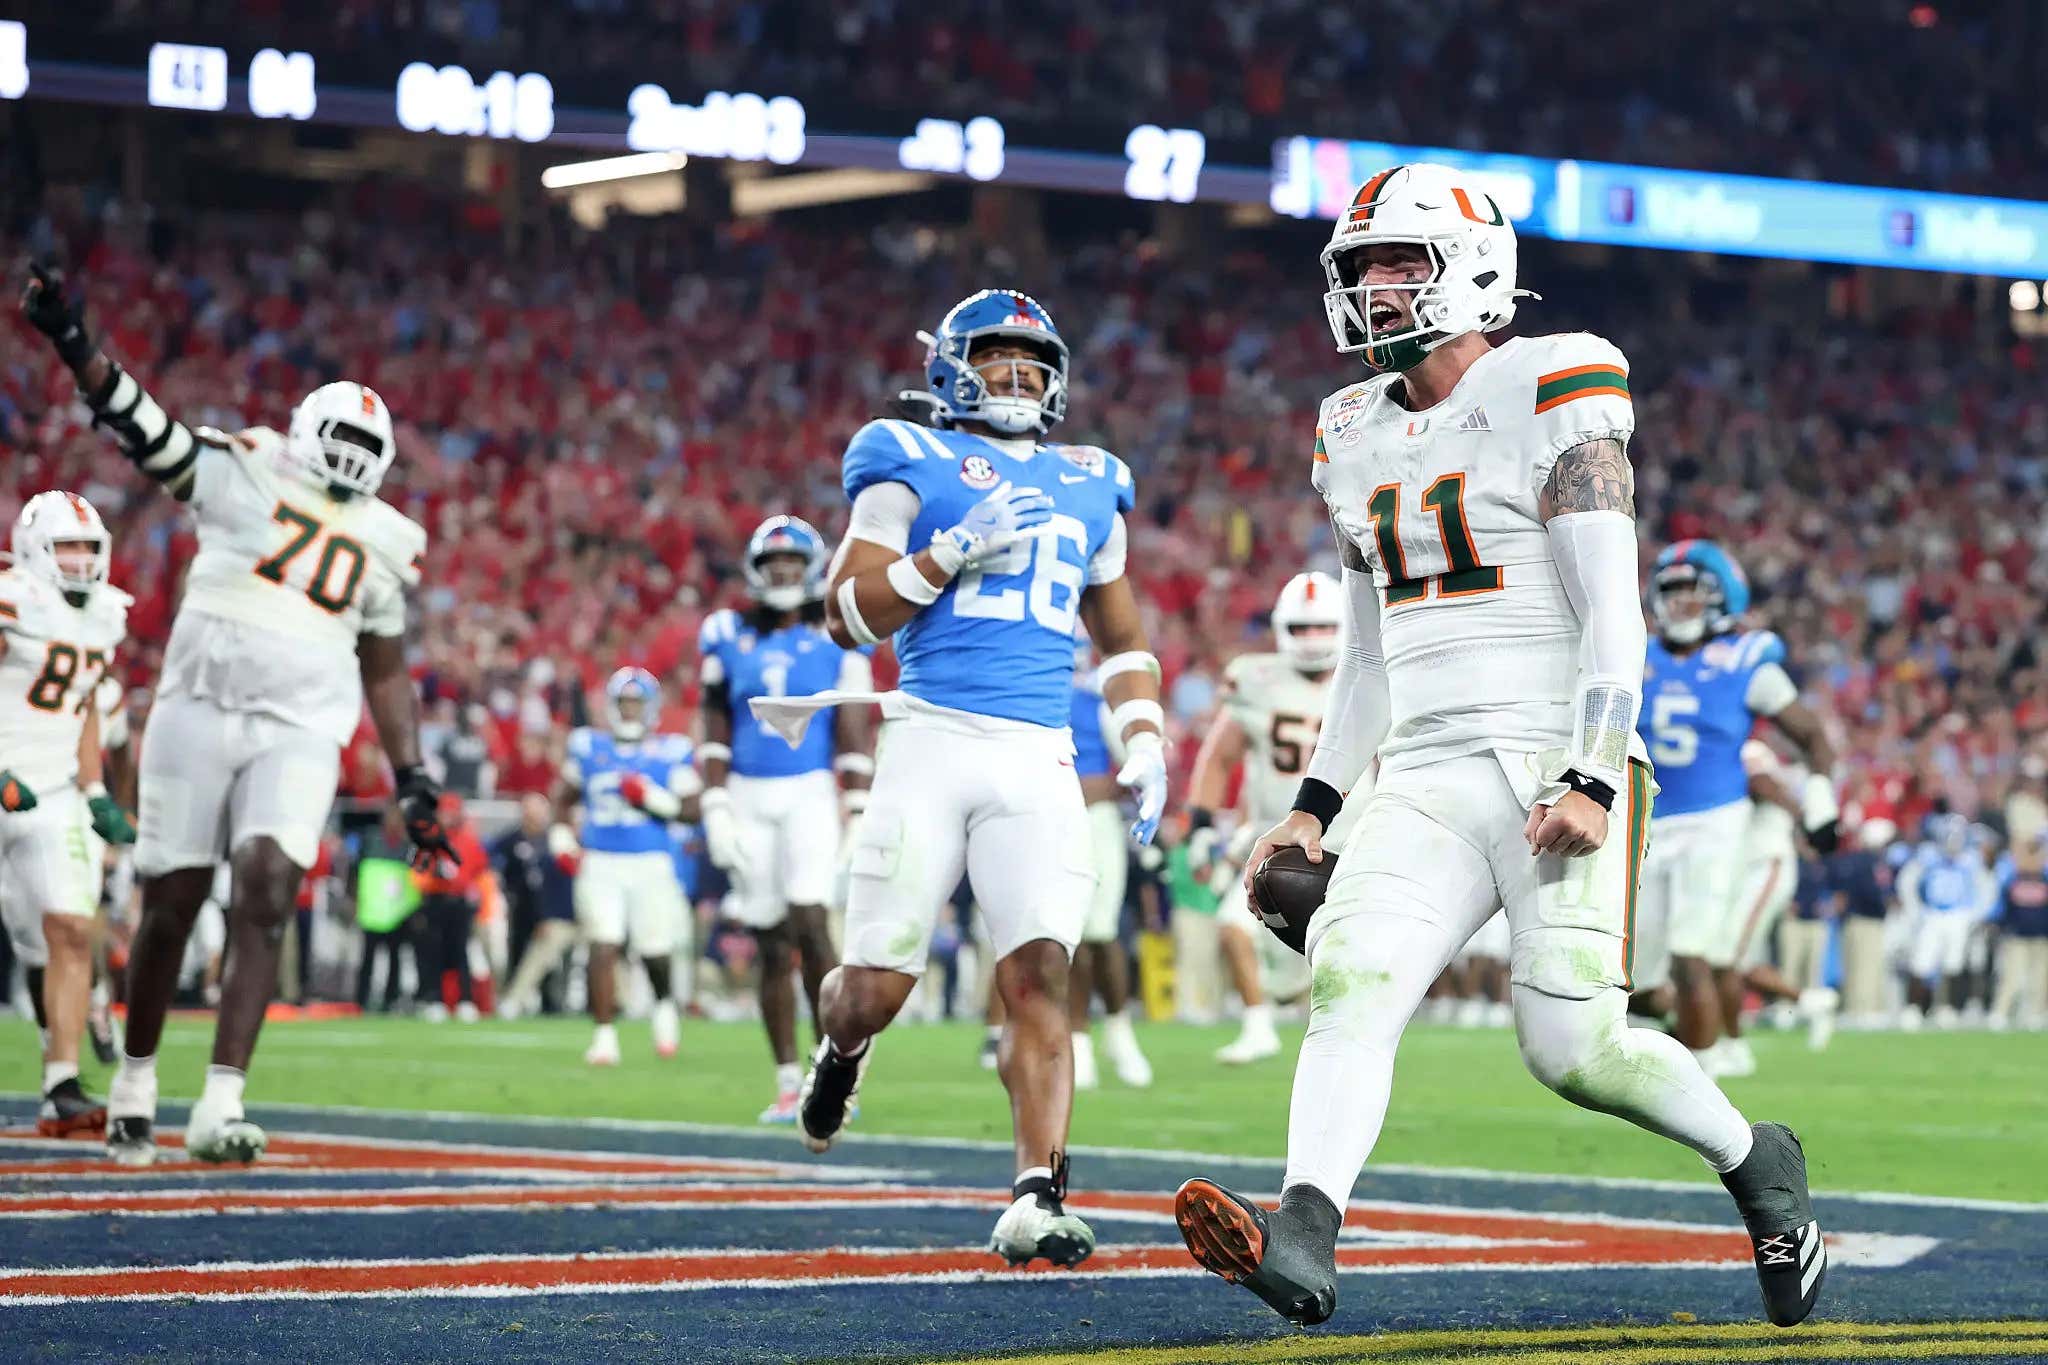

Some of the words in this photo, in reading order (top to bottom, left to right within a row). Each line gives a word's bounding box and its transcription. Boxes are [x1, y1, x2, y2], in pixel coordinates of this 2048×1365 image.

[1451, 187, 1504, 226] U
[255, 500, 368, 614] 70
[953, 513, 1088, 636] 26
[1367, 472, 1504, 608] 11
[1271, 712, 1321, 774] 5
[1652, 695, 1699, 768] 5
